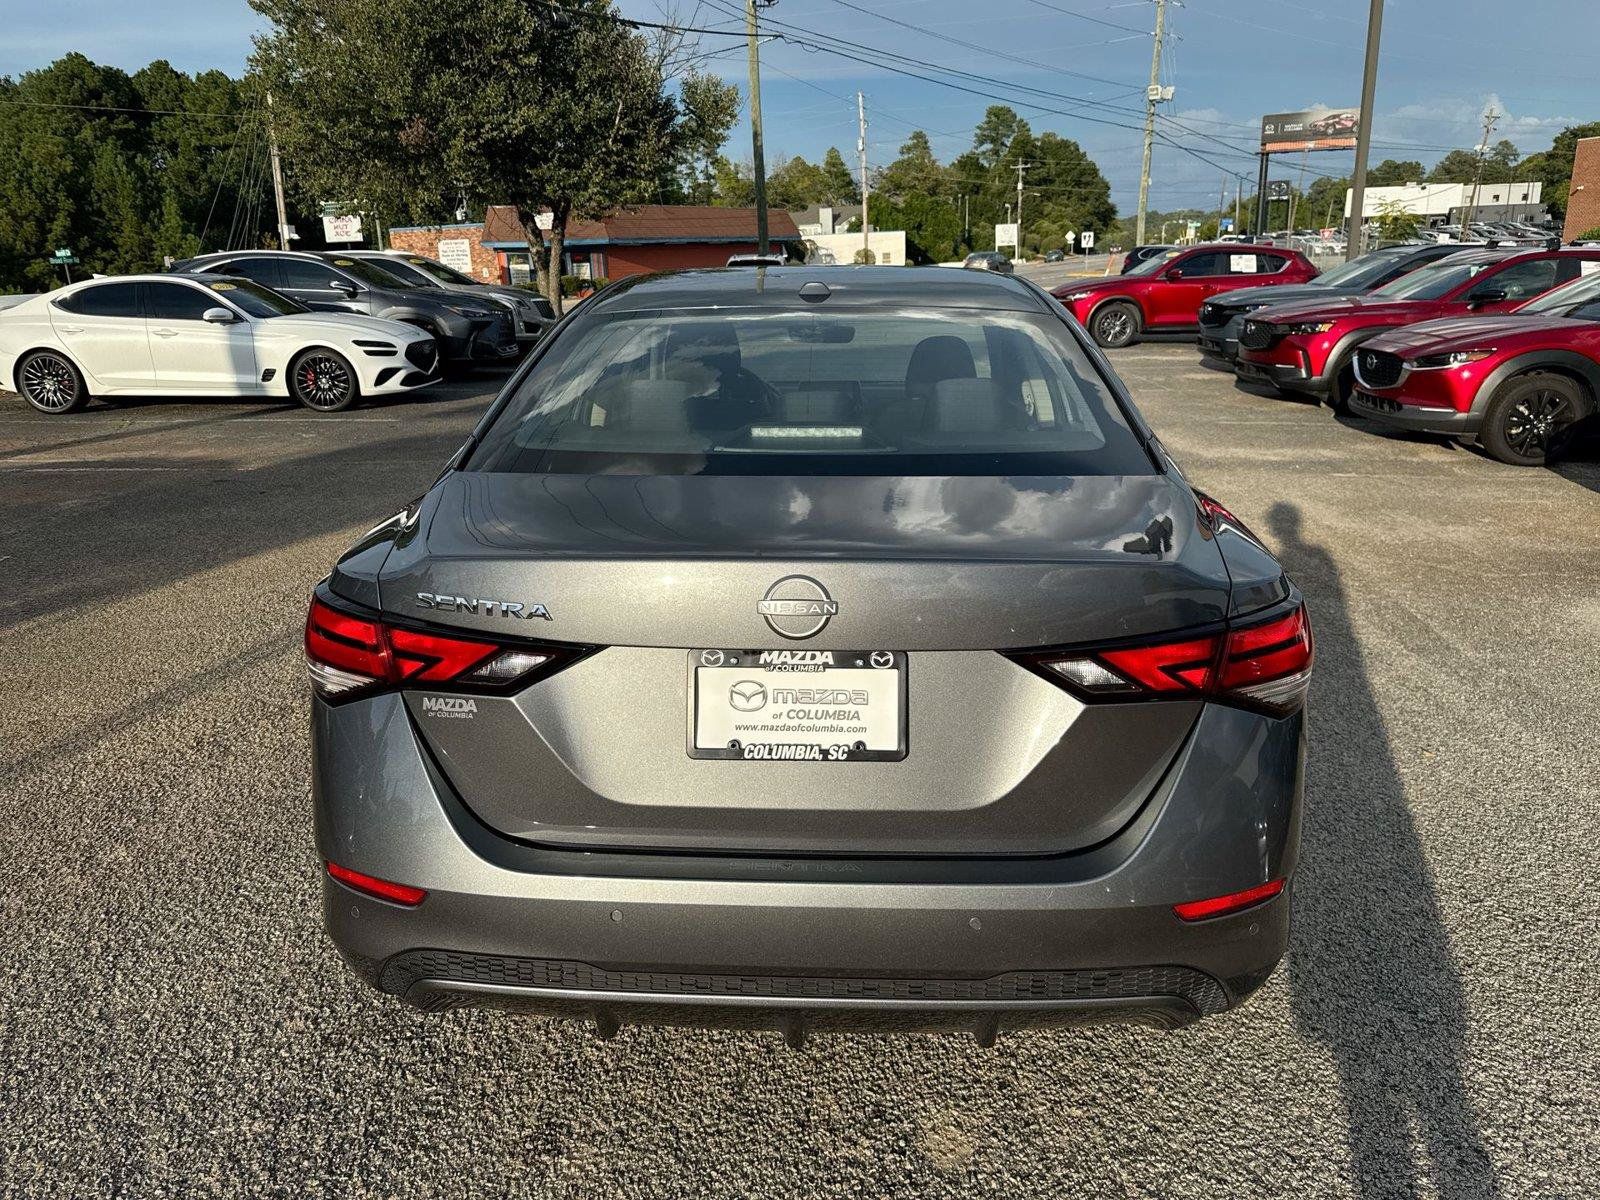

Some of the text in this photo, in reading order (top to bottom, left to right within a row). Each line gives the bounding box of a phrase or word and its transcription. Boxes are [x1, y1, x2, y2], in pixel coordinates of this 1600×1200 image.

[416, 592, 554, 621] SENTRA
[759, 602, 837, 614] NISSAN
[758, 650, 835, 665] MAZDA
[765, 664, 825, 673] of COLUMBIA
[422, 697, 478, 713] MAZDA
[436, 710, 474, 720] COLUMBIA
[772, 709, 861, 722] of COLUMBIA
[734, 723, 868, 734] www.mazdaofcolumbia.com
[743, 743, 848, 761] COLUMBIA, SC
